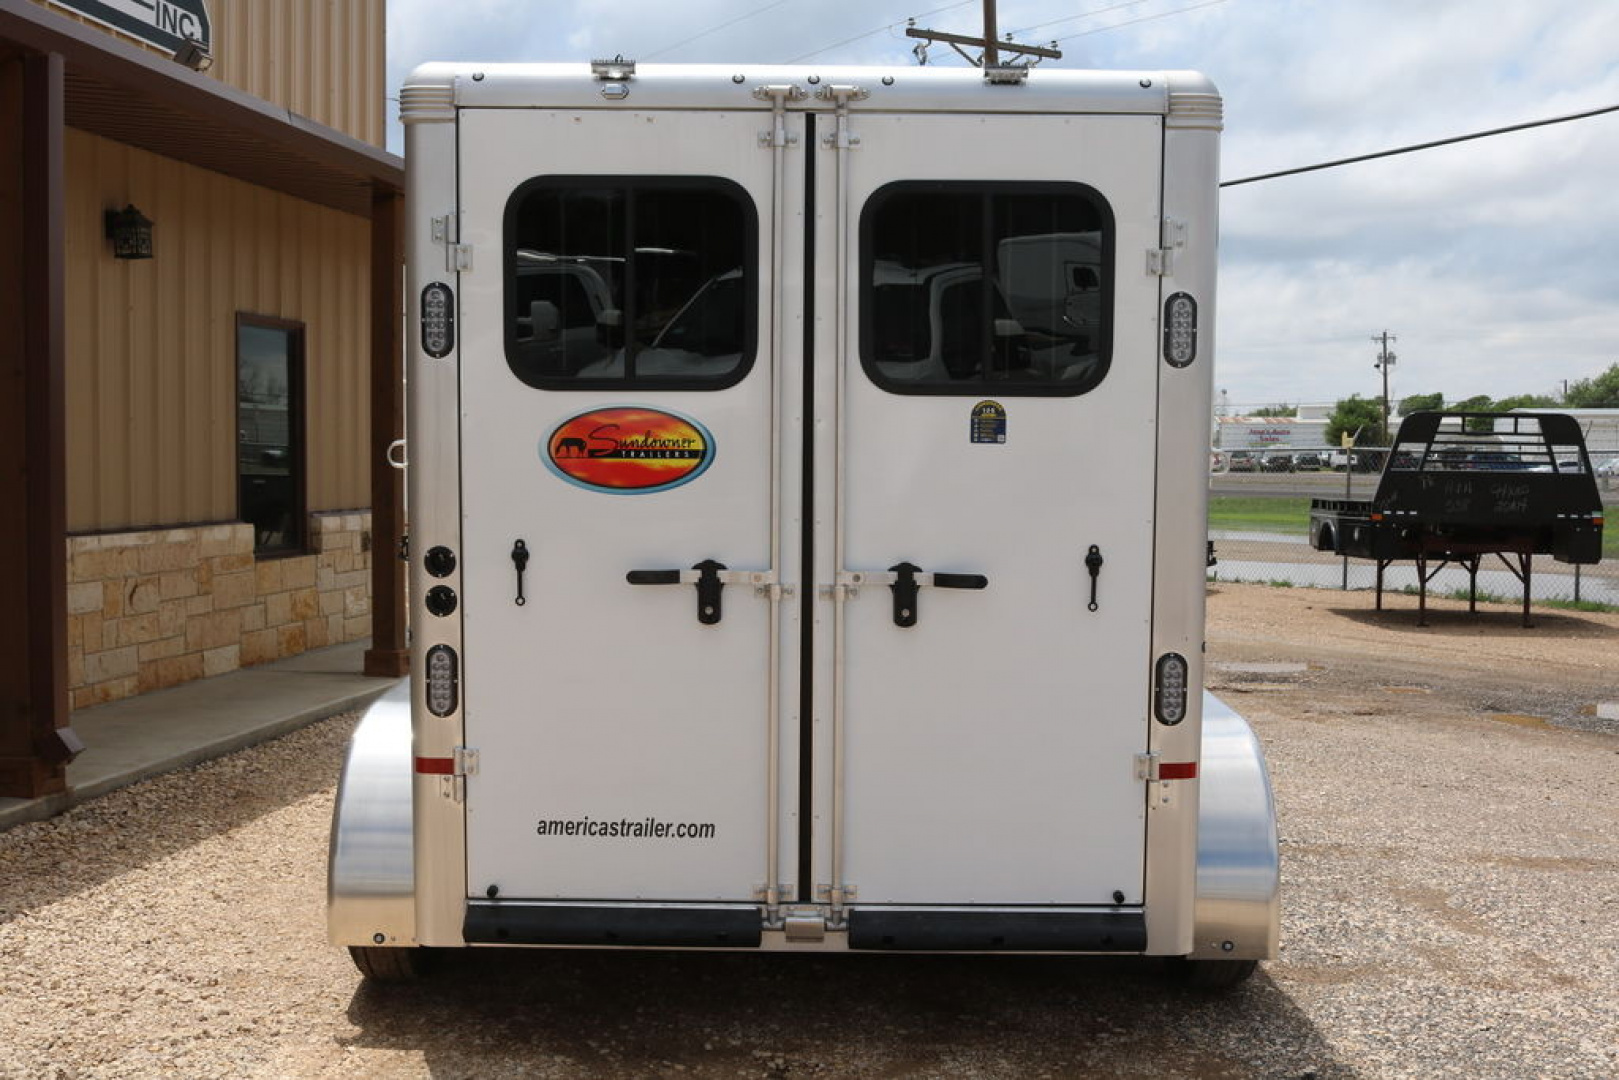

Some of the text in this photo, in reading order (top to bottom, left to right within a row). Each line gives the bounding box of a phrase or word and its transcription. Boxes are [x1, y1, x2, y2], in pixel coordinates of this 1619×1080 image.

[588, 423, 695, 456] Sundowner
[621, 450, 690, 459] TRAILERS
[536, 816, 716, 839] americastrailer.com
